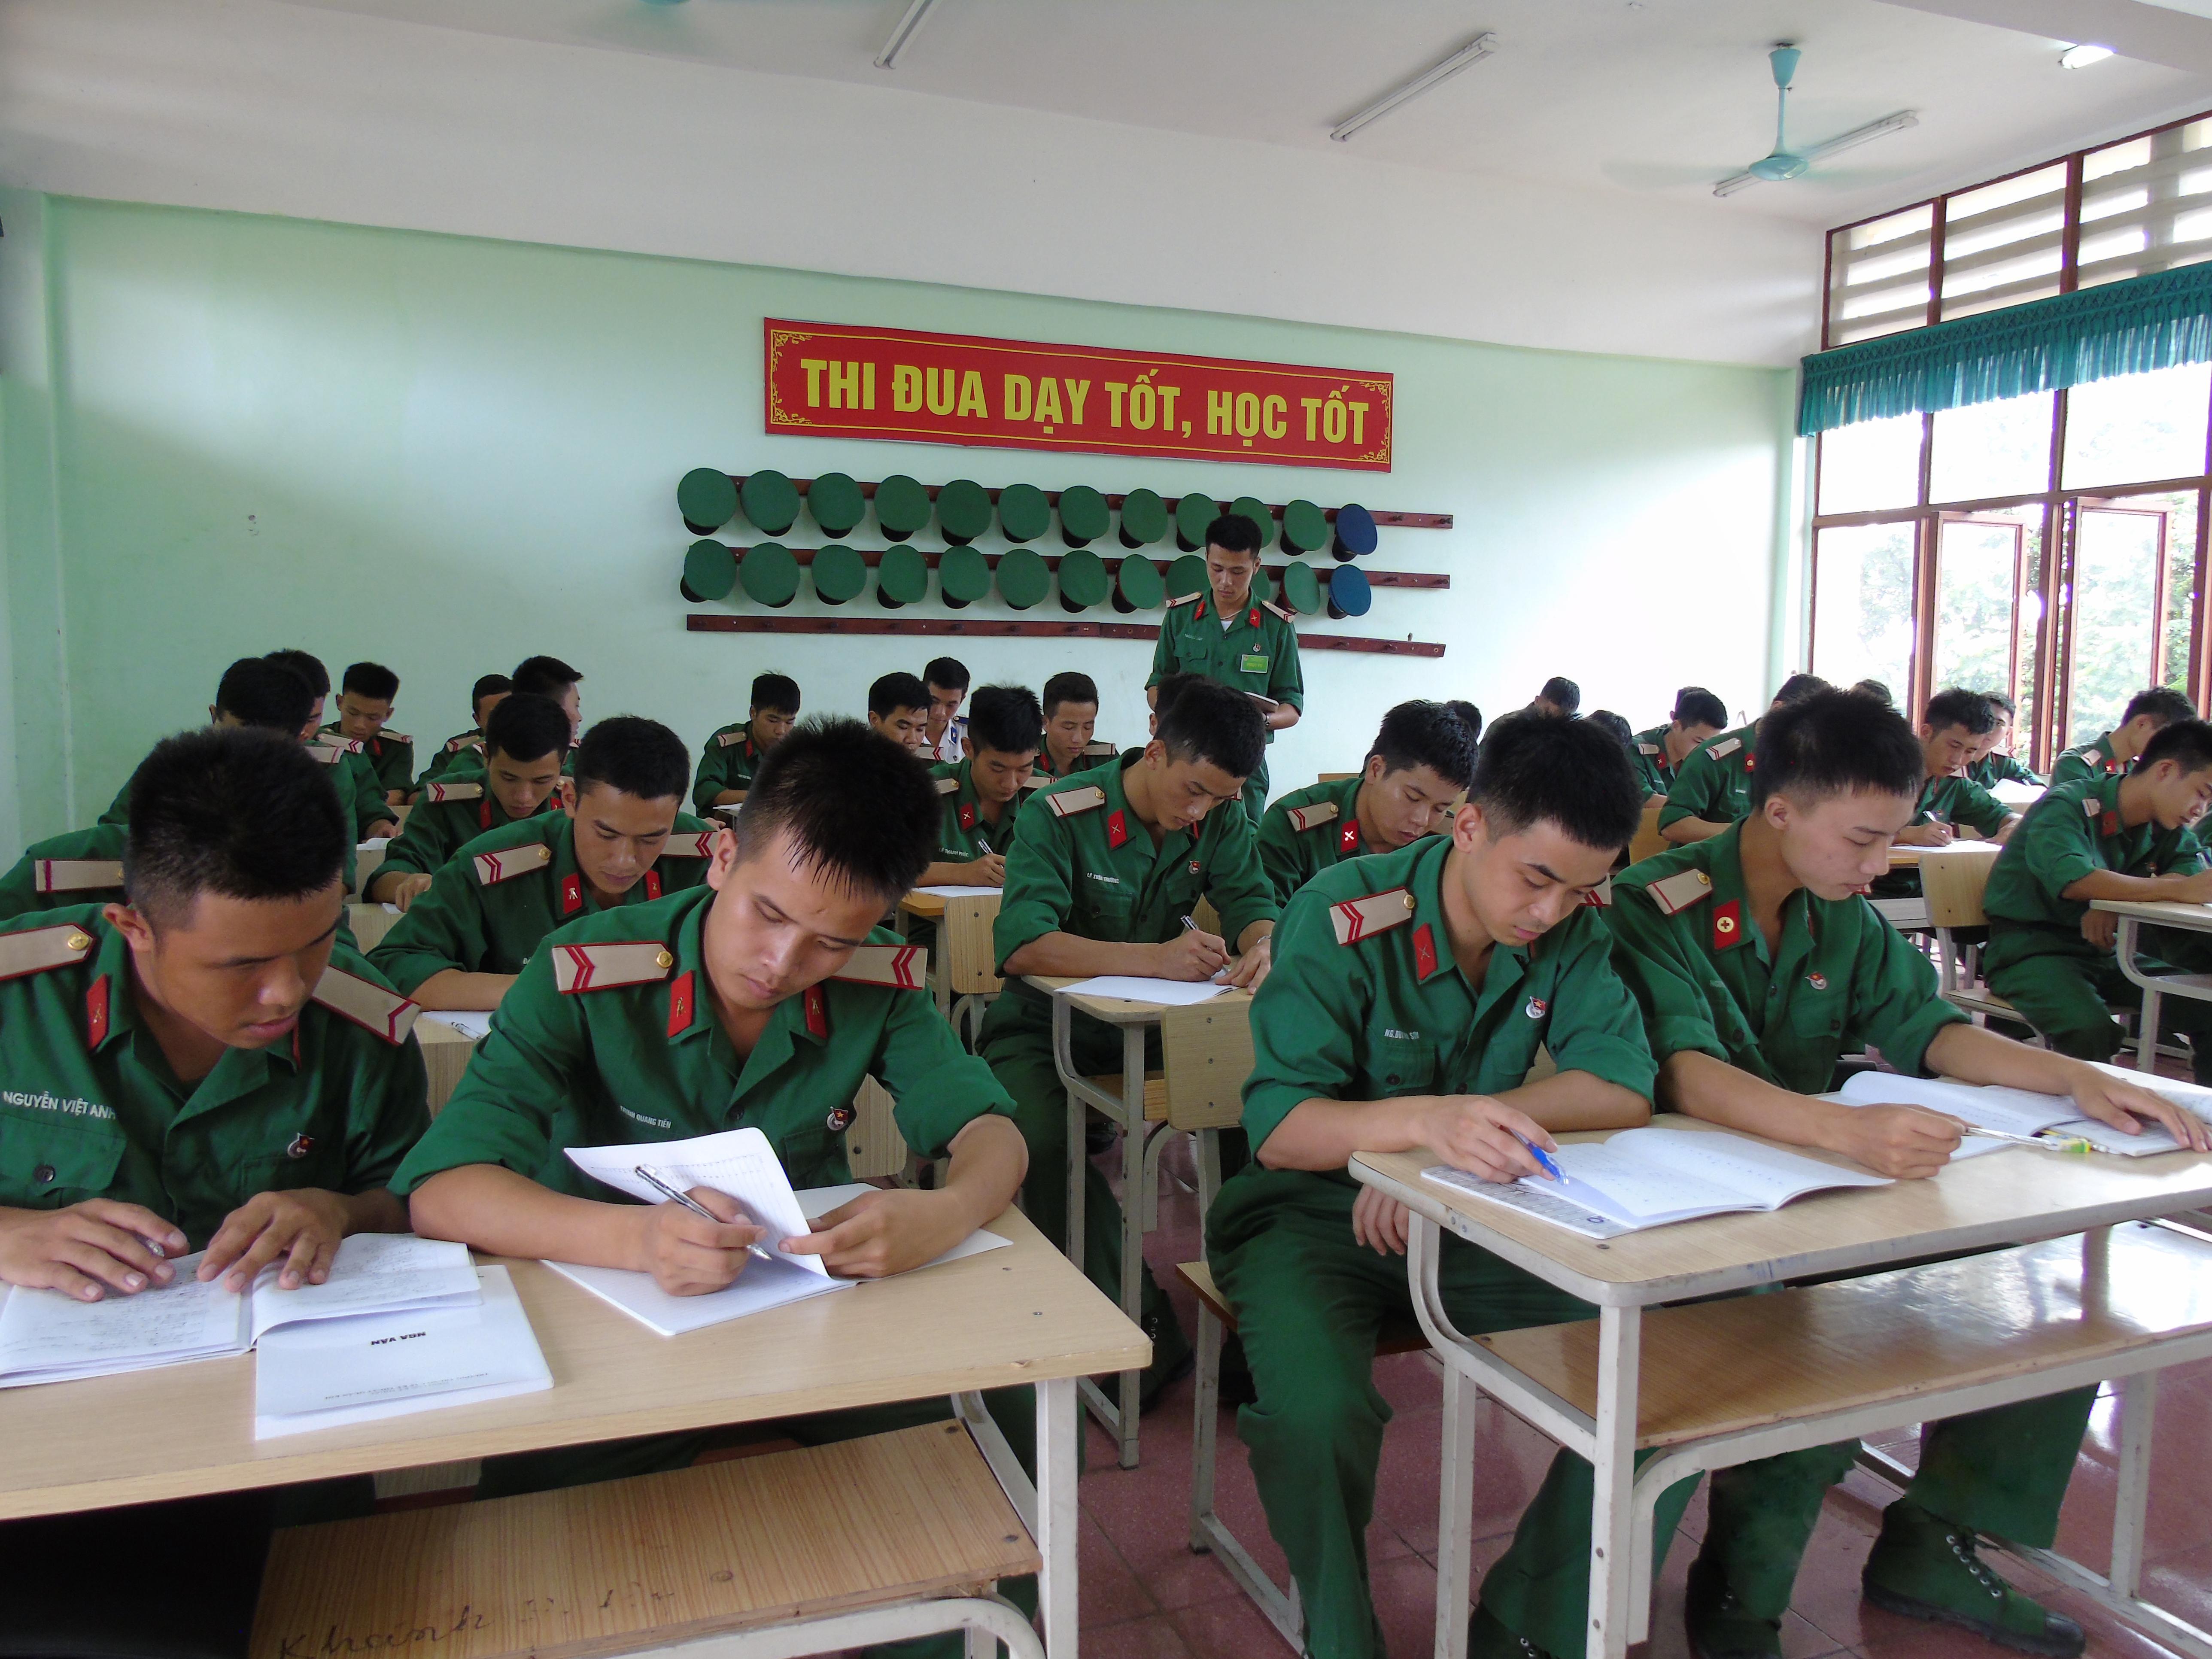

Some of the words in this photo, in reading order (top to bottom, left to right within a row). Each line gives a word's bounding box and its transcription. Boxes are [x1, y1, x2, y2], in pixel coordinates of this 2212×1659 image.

[801, 359, 875, 410] THI
[892, 364, 988, 419] ĐUA
[1004, 374, 1091, 434] DẠY
[1105, 369, 1191, 438] TỐT,
[1207, 389, 1287, 447] HỌC
[1301, 385, 1369, 445] TỐT
[3, 1090, 59, 1110] NGUYỄN
[62, 1098, 89, 1116] VIỆT
[636, 1113, 657, 1126] QUANG
